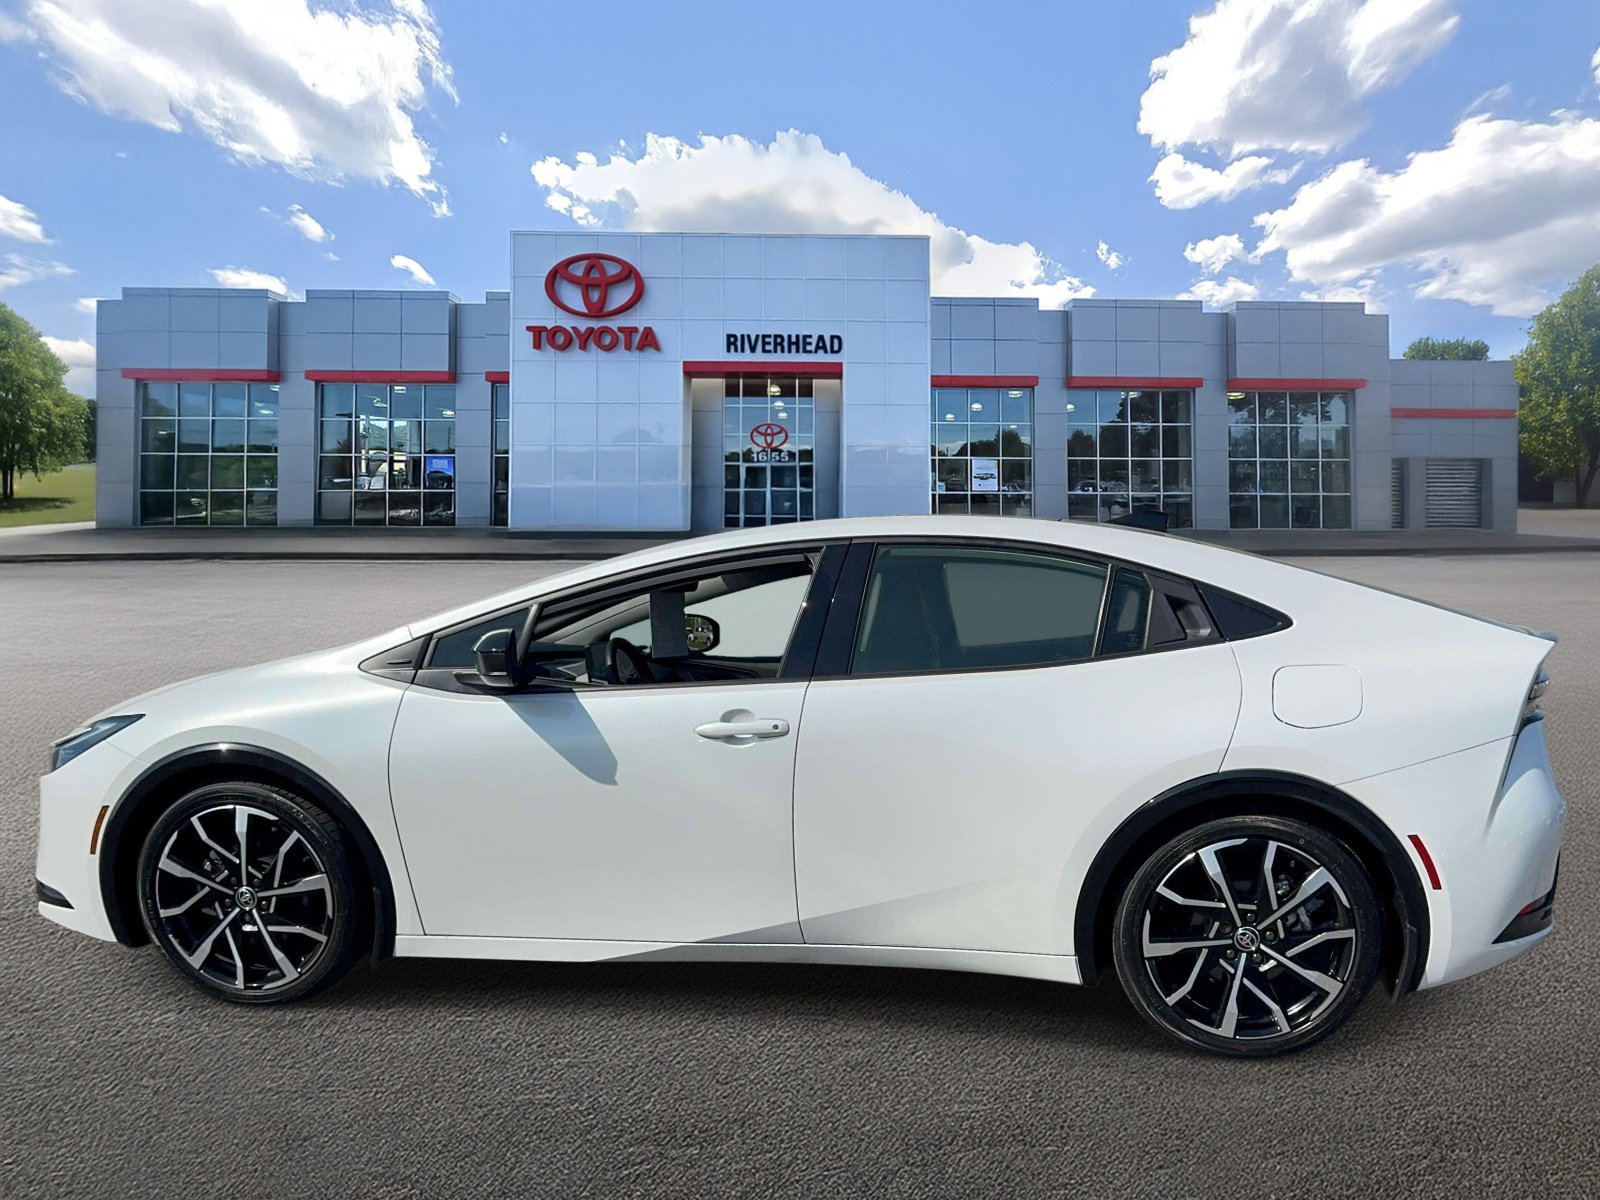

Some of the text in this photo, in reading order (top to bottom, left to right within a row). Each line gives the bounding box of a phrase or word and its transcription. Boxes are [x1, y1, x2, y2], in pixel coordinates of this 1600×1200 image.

[525, 325, 661, 352] TOYOTA
[725, 333, 843, 355] RIVERHEAD
[751, 451, 789, 462] 1655
